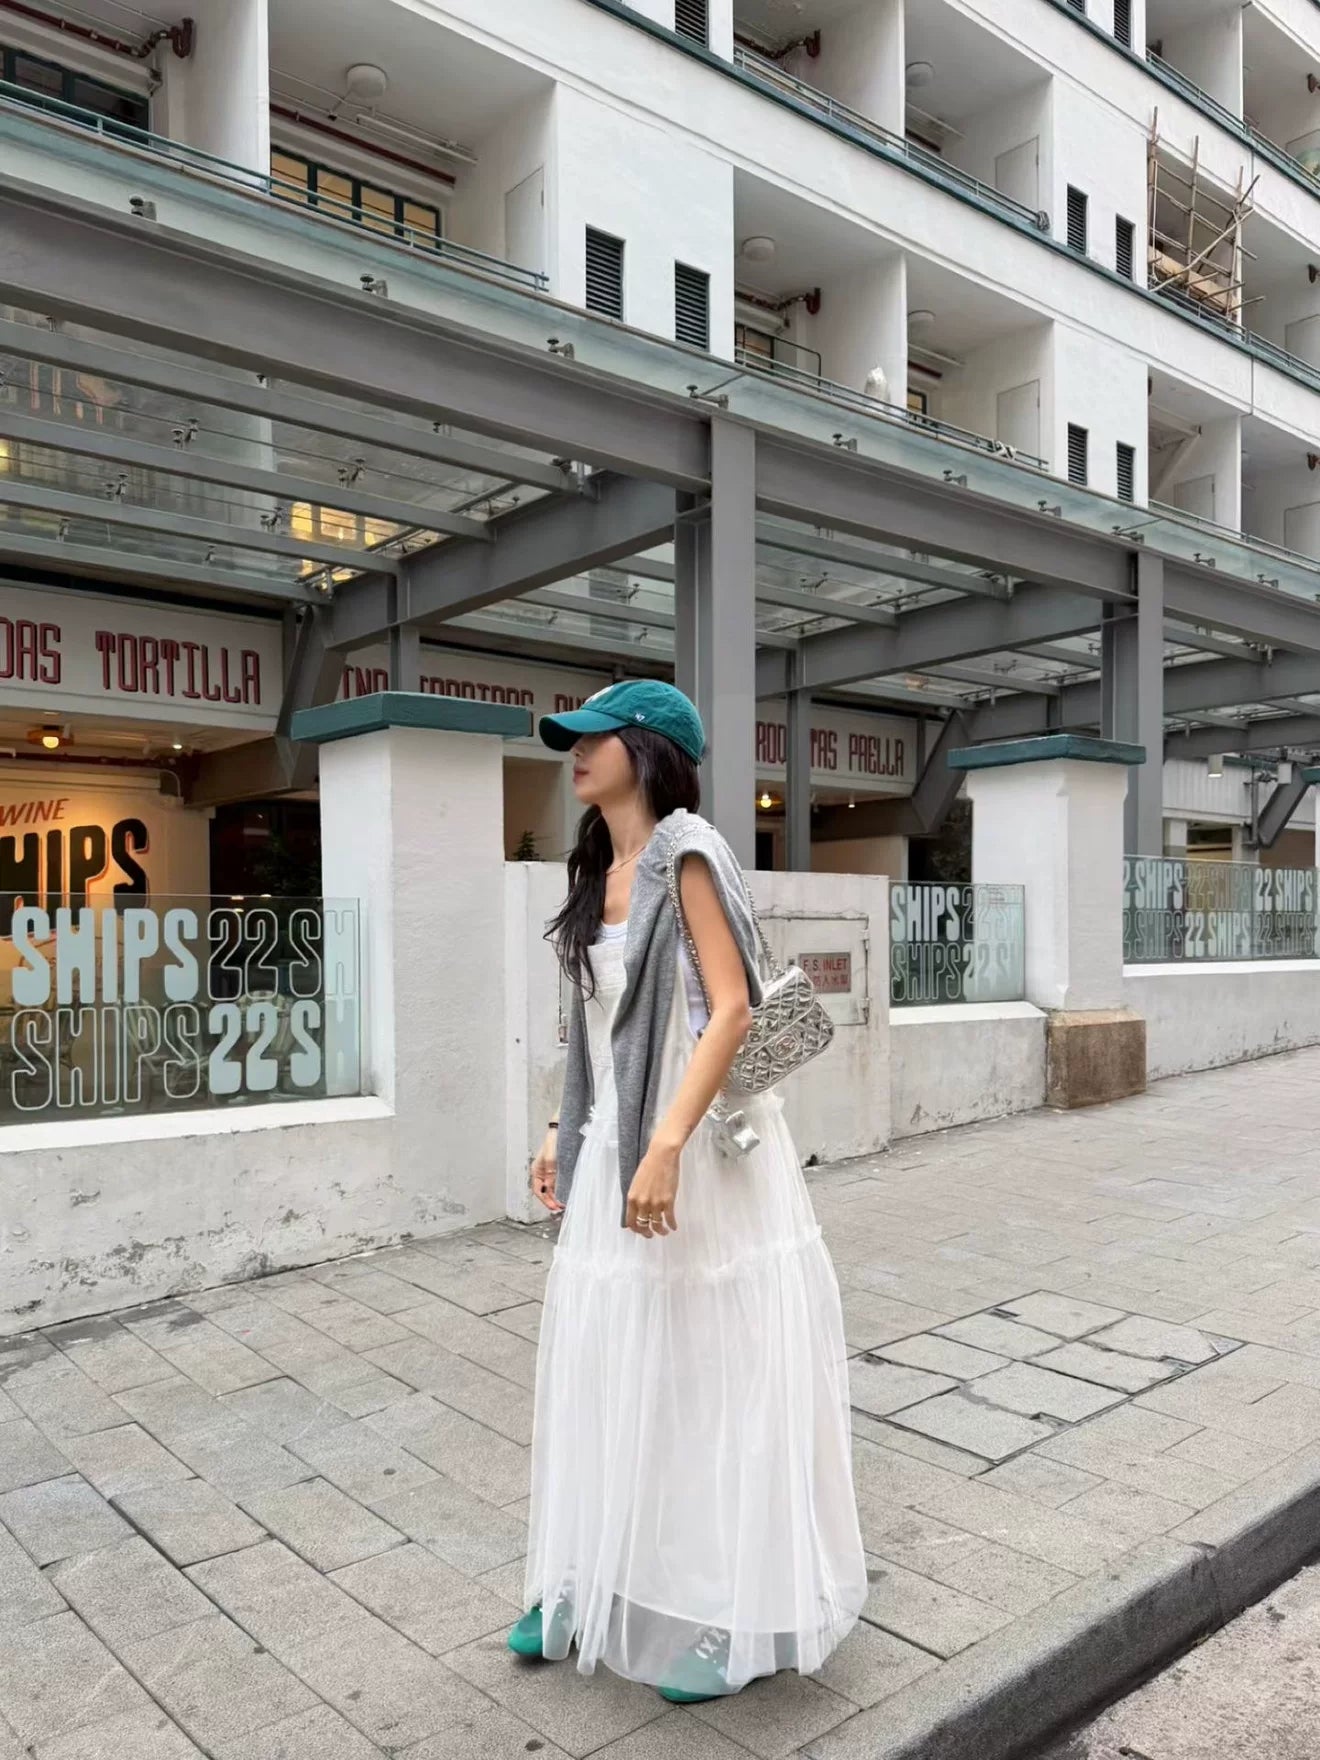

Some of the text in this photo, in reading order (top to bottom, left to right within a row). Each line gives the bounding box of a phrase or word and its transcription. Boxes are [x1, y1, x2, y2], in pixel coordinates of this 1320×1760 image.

[95, 631, 261, 704] TORTILLA
[848, 733, 904, 776] PAELLA
[0, 799, 69, 826] WINE
[1135, 861, 1184, 909] SHIPS
[1255, 868, 1273, 911] 22
[1275, 869, 1314, 911] SHIPS
[891, 886, 960, 941] SHIPS
[1134, 910, 1184, 959] SHIPS
[1185, 912, 1205, 957] 22
[1207, 912, 1251, 957] SHIPS
[12, 906, 198, 1006] SHIPS
[208, 908, 279, 1001] 22
[823, 958, 847, 971] INLET
[891, 942, 960, 1001] SHIPS
[12, 1004, 201, 1111] SHIPS
[209, 1003, 279, 1095] 22
